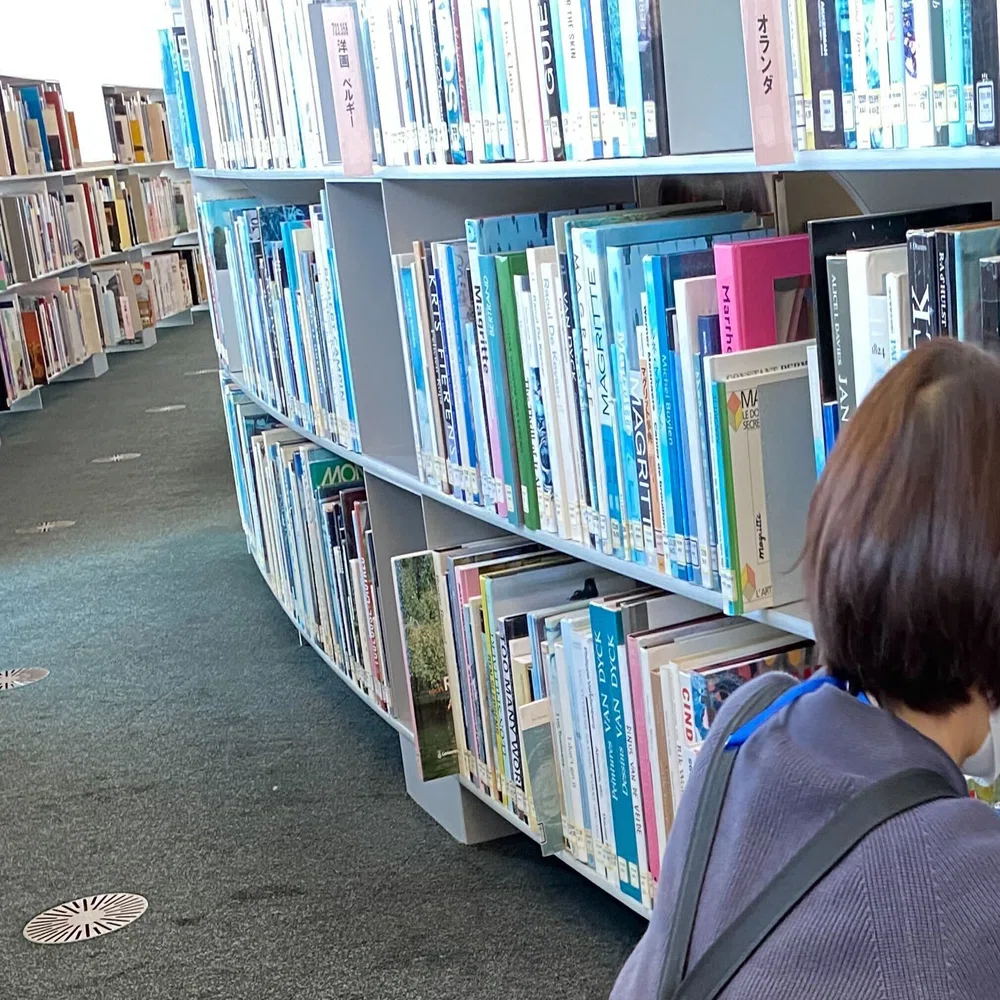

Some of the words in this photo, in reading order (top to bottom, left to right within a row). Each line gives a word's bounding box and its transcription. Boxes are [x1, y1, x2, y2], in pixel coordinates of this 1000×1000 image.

[337, 39, 351, 68] 洋画
[757, 14, 775, 94] オランダ
[342, 78, 356, 128] ベルギー
[429, 274, 442, 331] KRIS
[483, 275, 496, 337] BERTRAND
[474, 284, 489, 374] Magritte
[587, 266, 611, 416] MAGRITTE
[664, 402, 674, 446] Buylen
[838, 375, 850, 422] JAN
[500, 635, 510, 679] TOO
[593, 631, 606, 684] DYCK
[606, 634, 619, 689] DYCK
[504, 680, 518, 733] MANY
[600, 694, 611, 732] VAN
[611, 698, 623, 738] VAN
[629, 762, 637, 782] VAN
